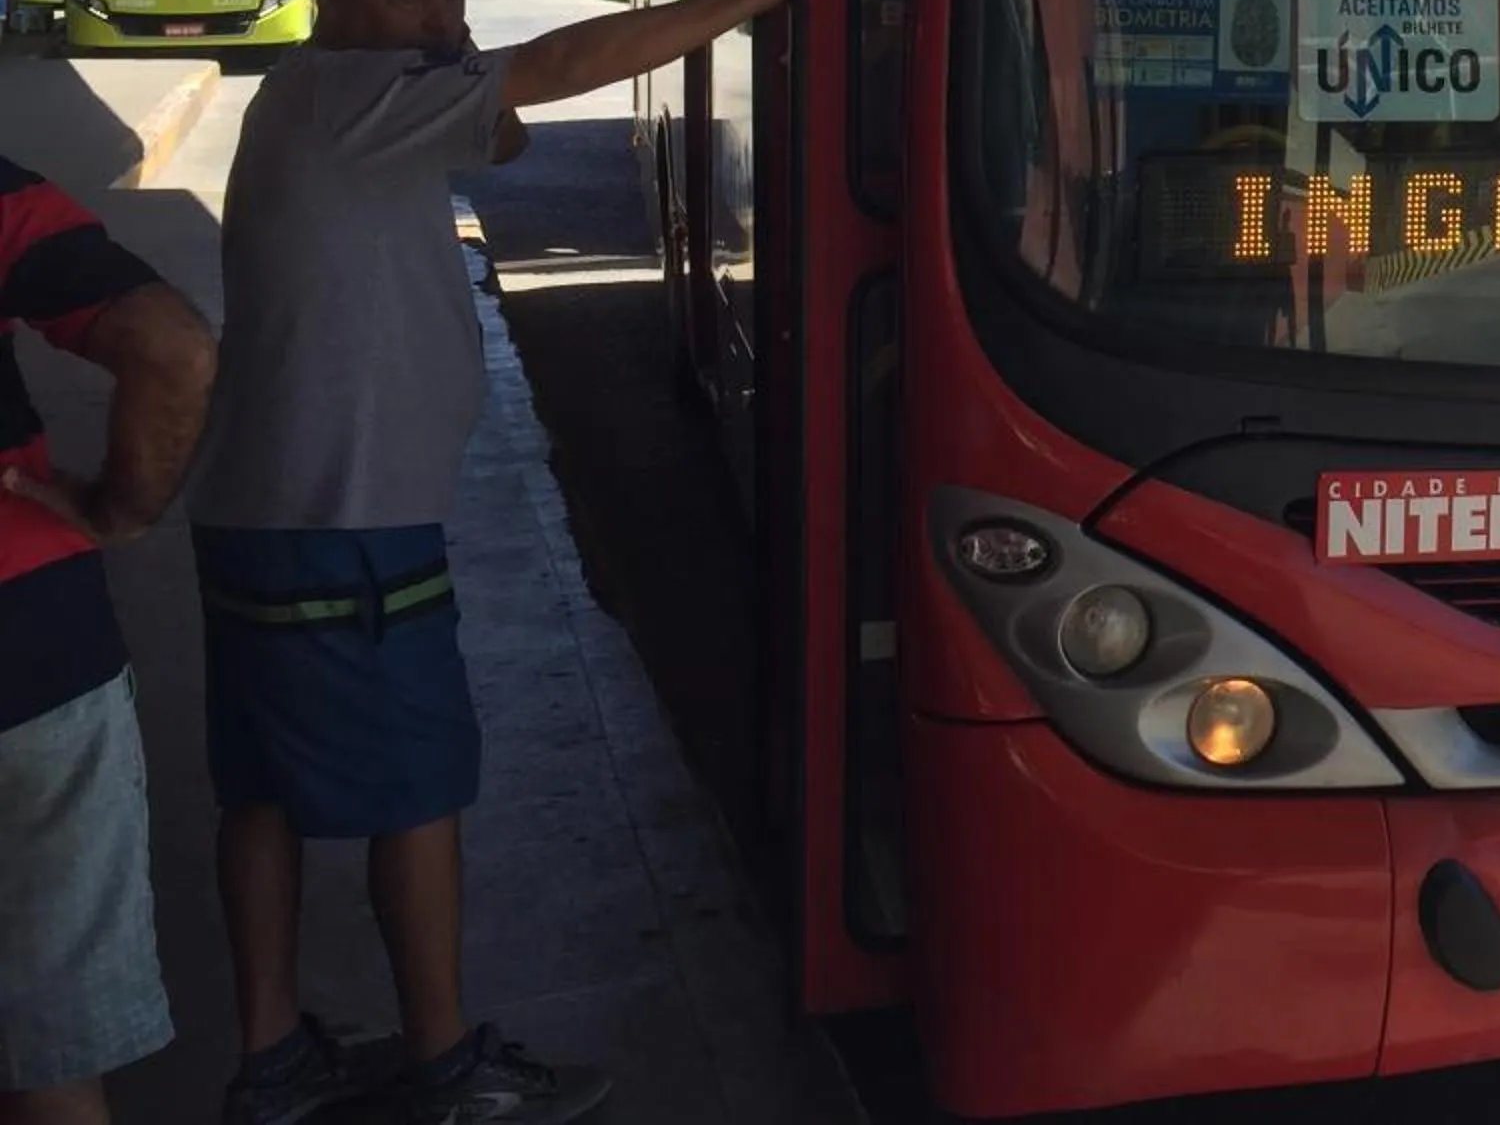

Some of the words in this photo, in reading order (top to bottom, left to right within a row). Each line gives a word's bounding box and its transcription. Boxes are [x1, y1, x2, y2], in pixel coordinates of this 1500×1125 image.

[1095, 6, 1216, 28] BIOMETRIA
[1402, 20, 1464, 35] BILHETE
[1316, 27, 1481, 103] ÚNICO
[1329, 477, 1466, 498] CIDADE
